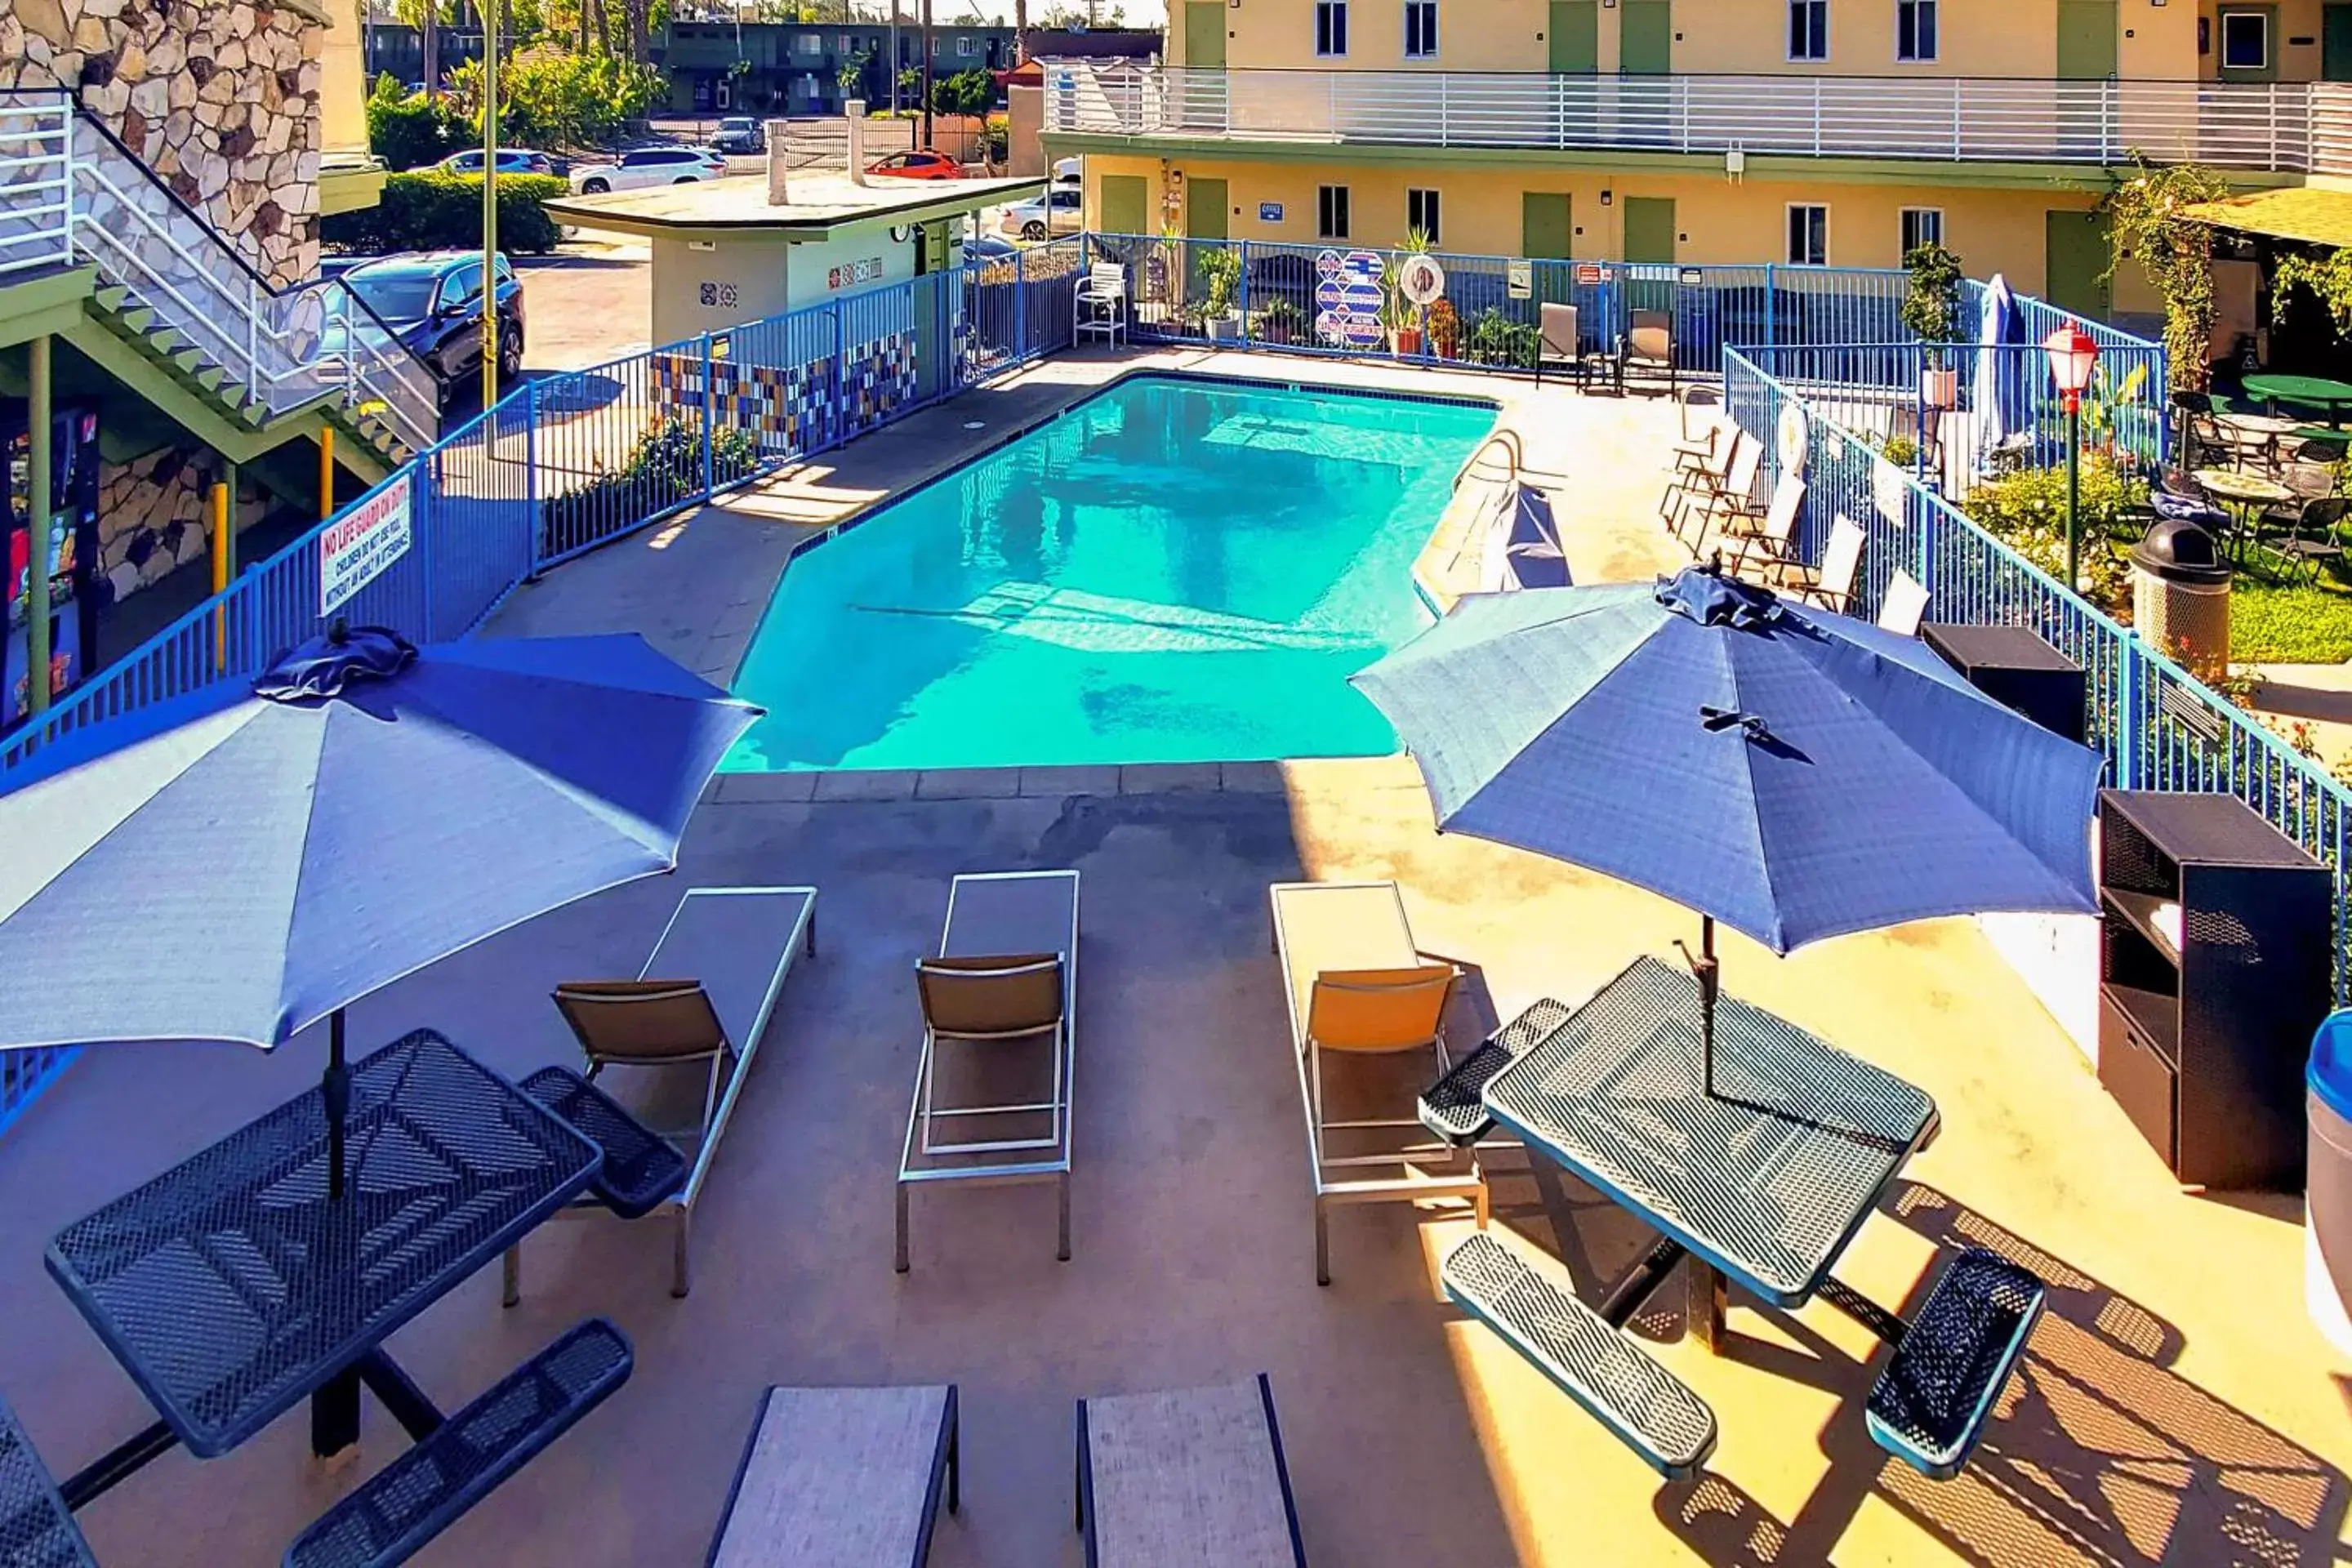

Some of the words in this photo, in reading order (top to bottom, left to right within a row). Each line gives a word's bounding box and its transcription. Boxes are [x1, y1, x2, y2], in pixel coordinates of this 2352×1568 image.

[323, 531, 336, 559] NO
[381, 497, 390, 520] ON
[391, 483, 408, 510] DUTY
